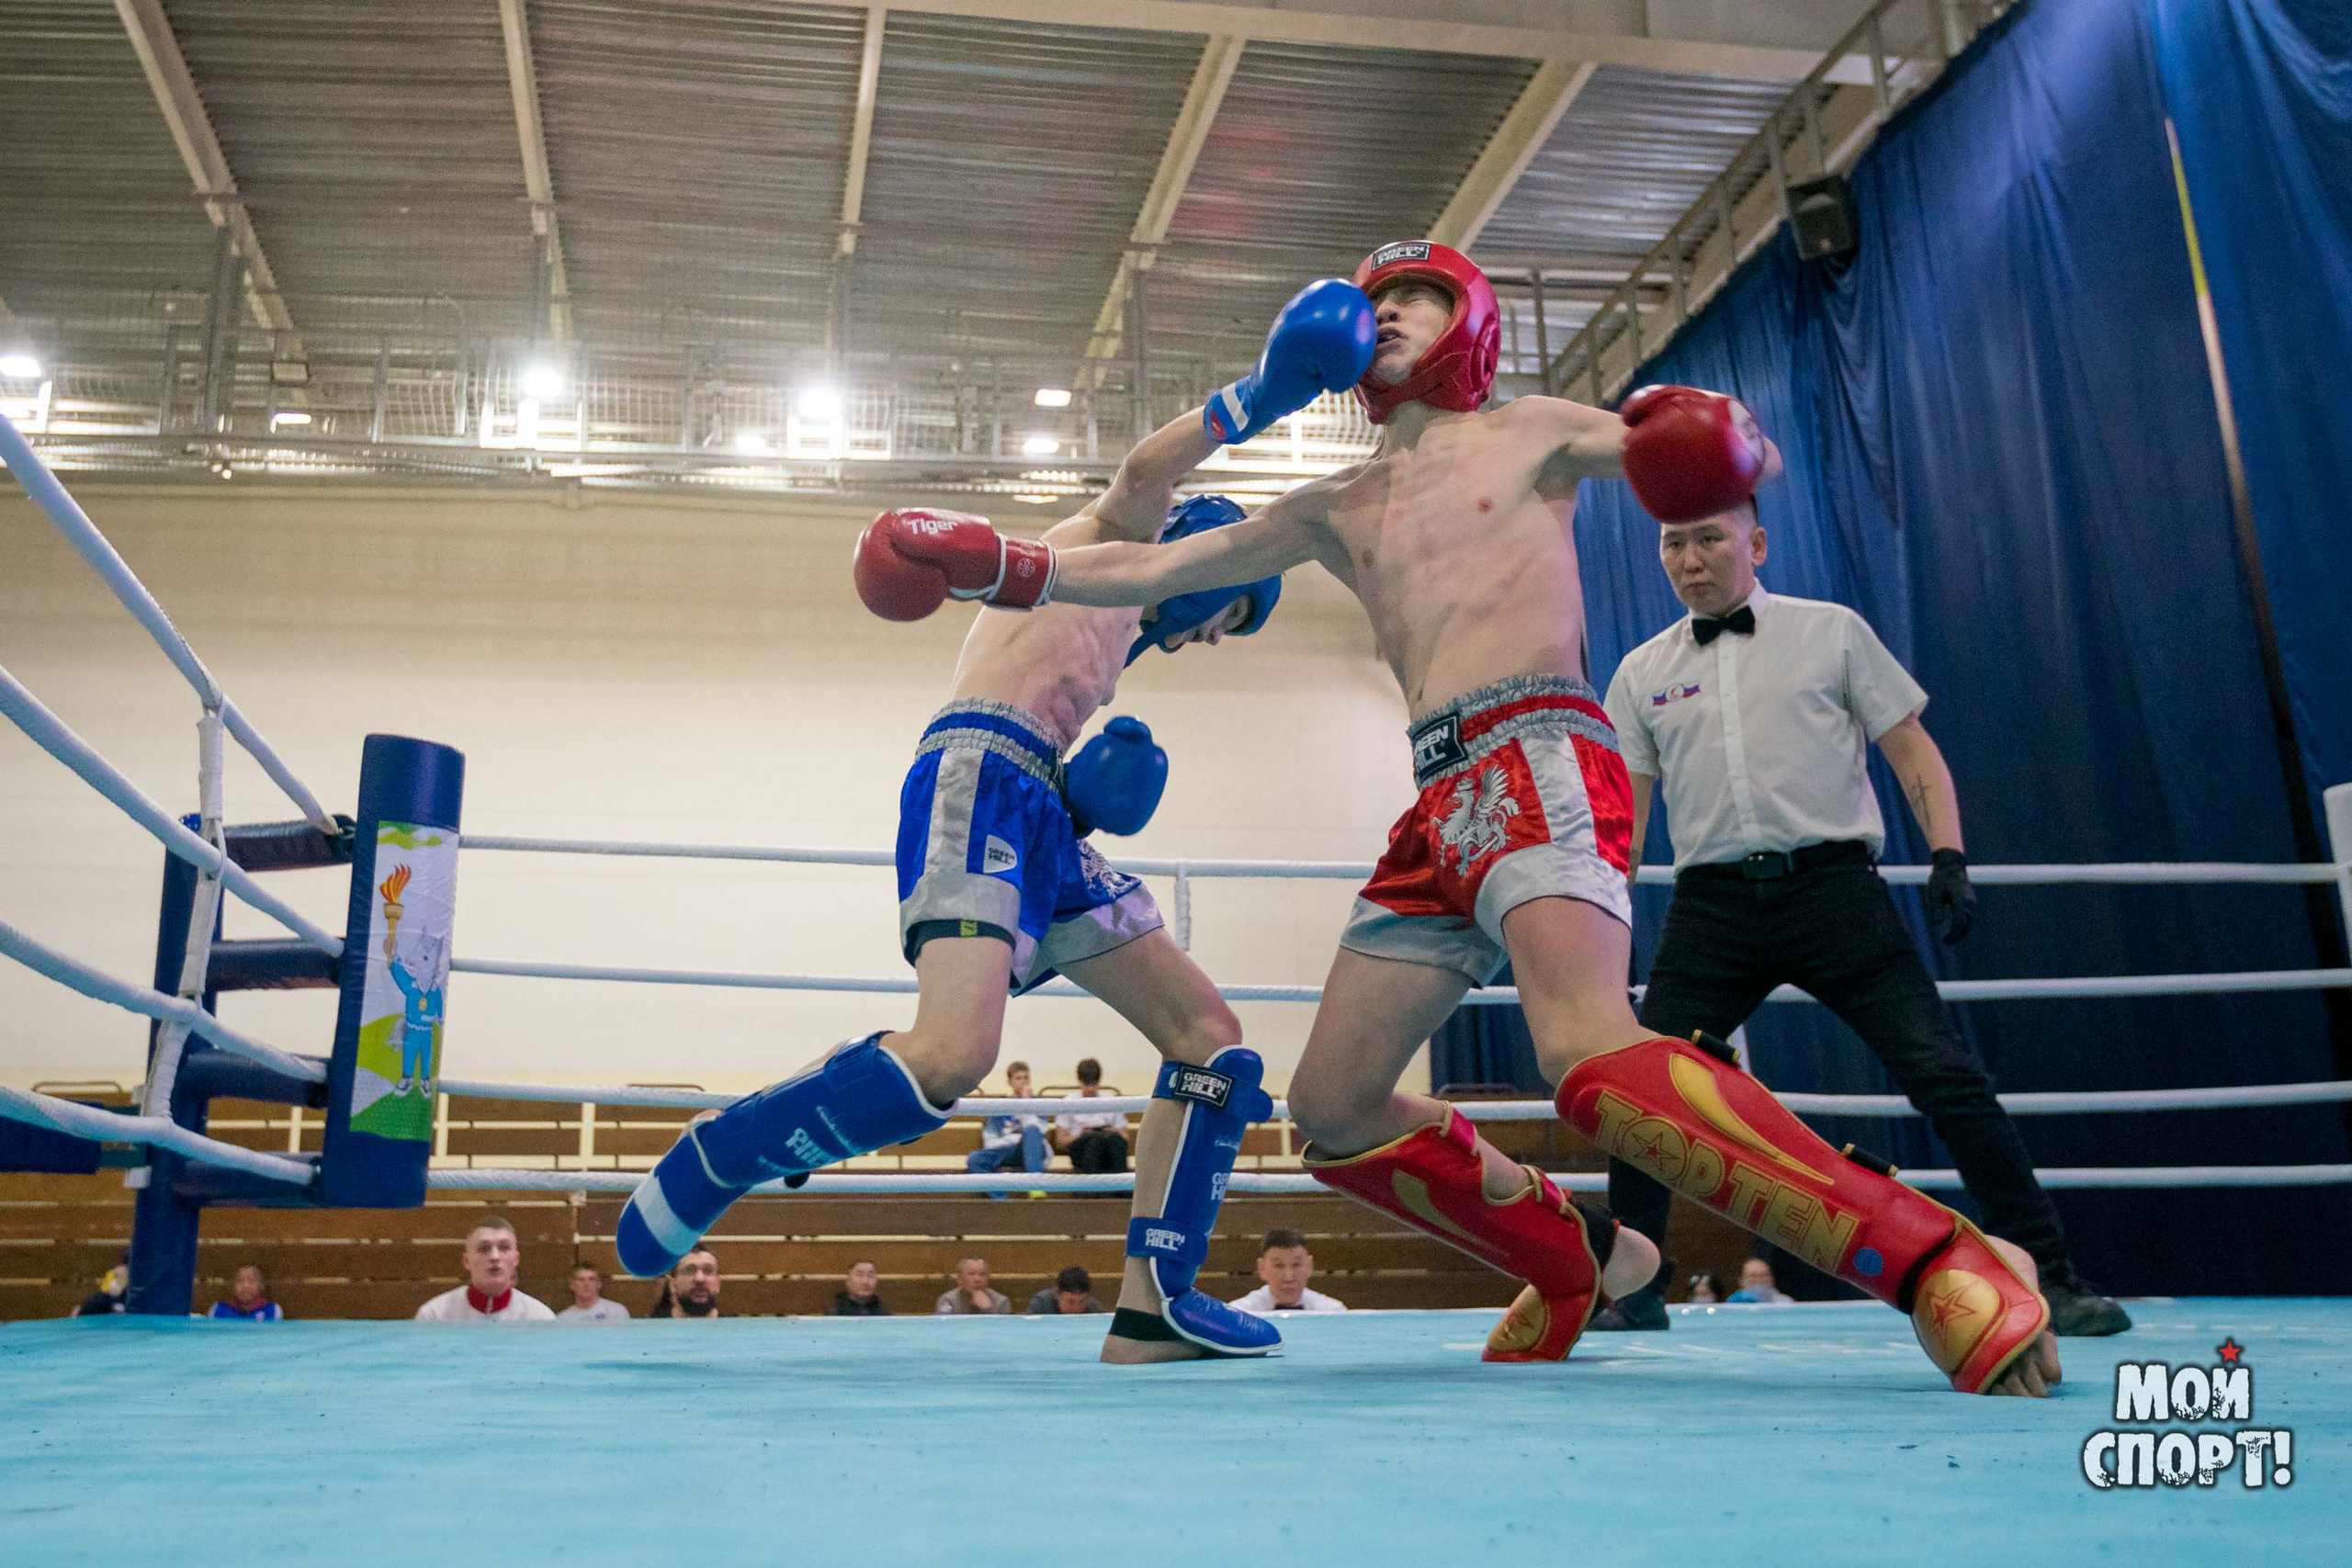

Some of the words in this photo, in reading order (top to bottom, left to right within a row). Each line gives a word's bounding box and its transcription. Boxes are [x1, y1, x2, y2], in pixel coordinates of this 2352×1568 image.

[907, 517, 958, 536] Tiger
[1181, 1081, 1217, 1099] HILL
[1183, 1072, 1227, 1091] GREEN
[1146, 1227, 1185, 1243] GREEN
[1146, 1235, 1179, 1251] HILL
